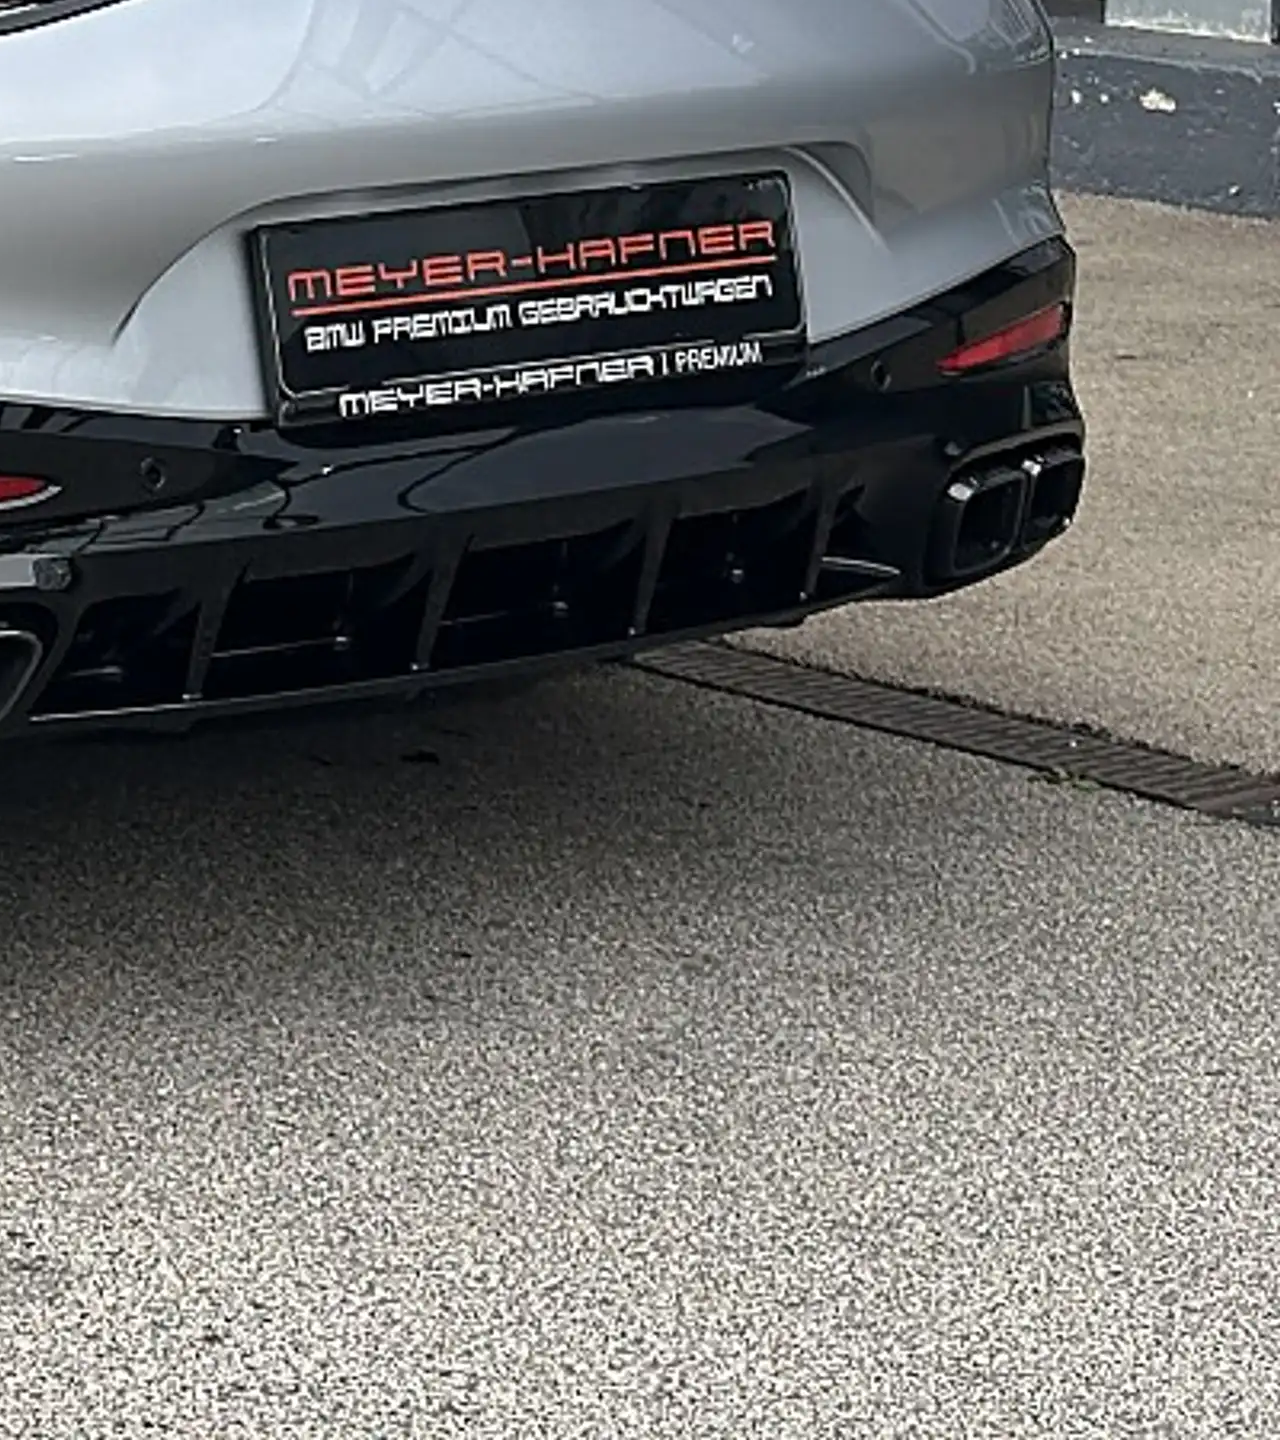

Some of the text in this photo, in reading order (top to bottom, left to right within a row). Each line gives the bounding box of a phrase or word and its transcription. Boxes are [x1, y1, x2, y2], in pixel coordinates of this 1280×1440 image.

[288, 220, 776, 302] MEYER-HAFNER
[304, 274, 774, 353] BMW PREMIUM GEBRAUCHTWAGEN
[339, 341, 764, 418] MEYER-HAFNER PREMIUM
